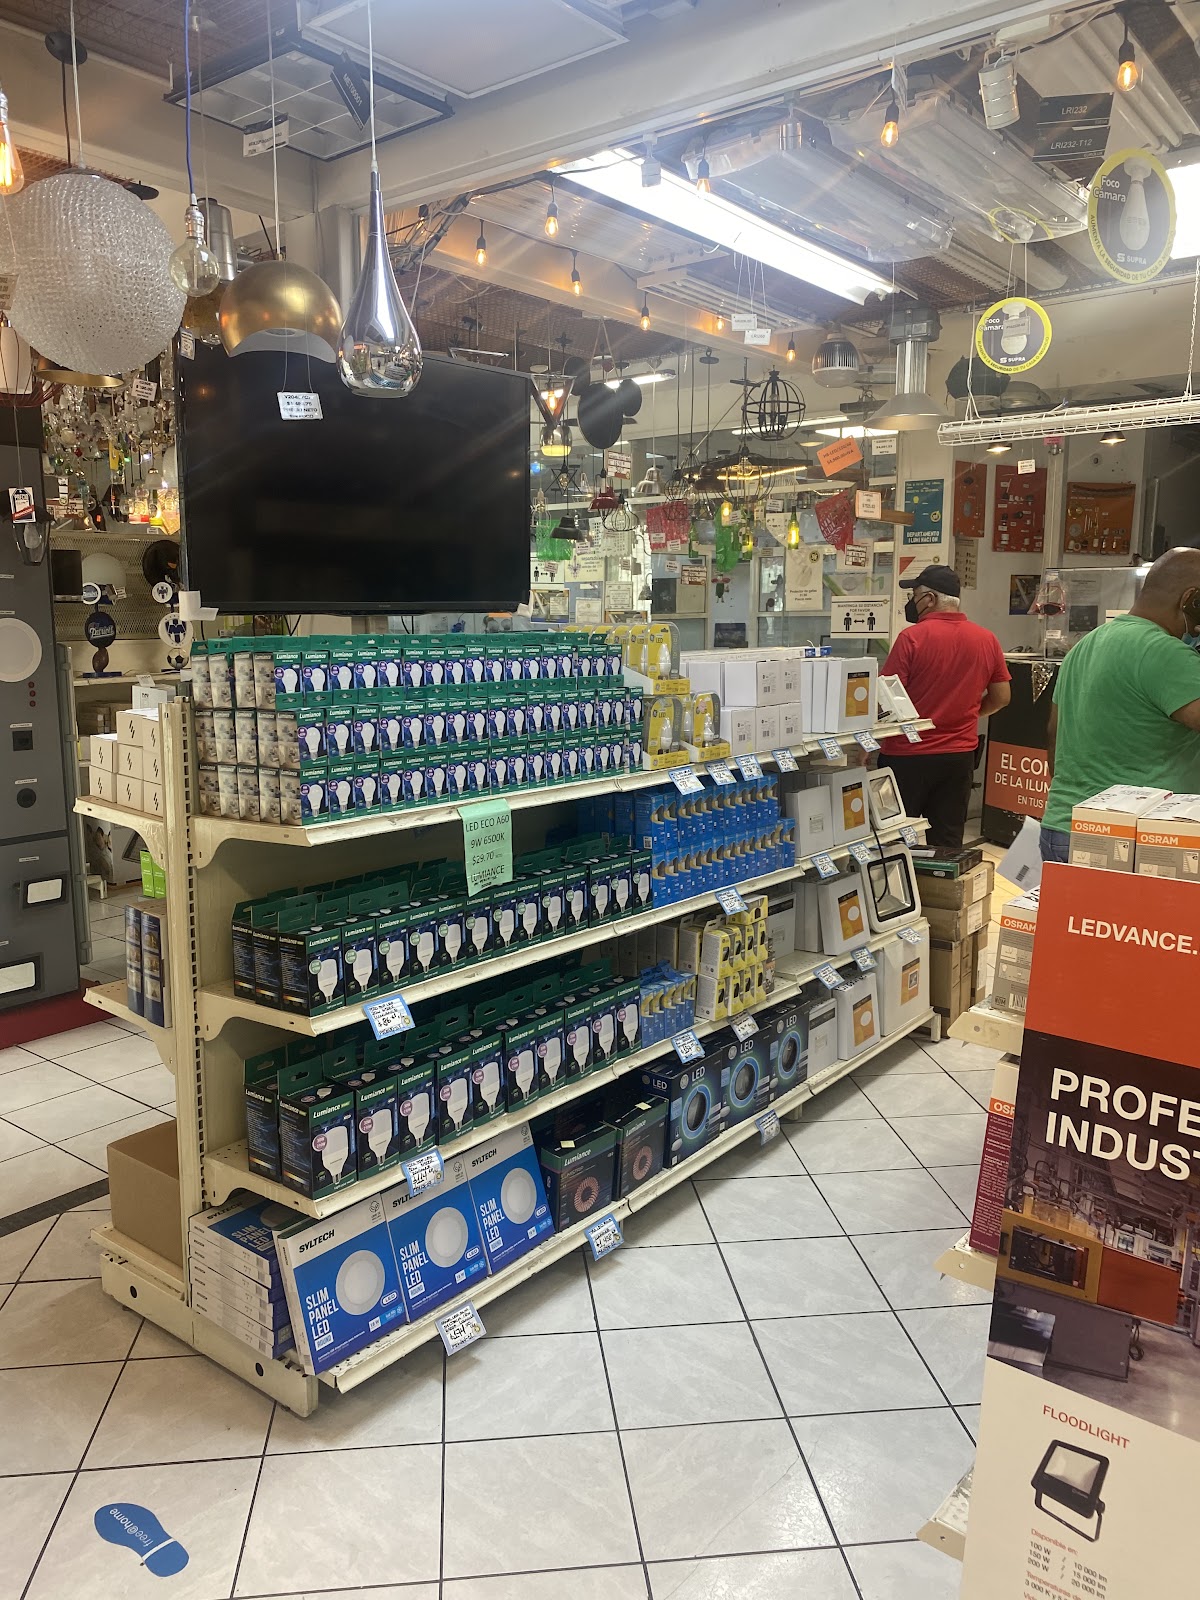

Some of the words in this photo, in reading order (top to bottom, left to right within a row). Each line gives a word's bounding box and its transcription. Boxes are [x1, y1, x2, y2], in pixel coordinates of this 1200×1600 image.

[1061, 105, 1088, 115] LRI232
[1101, 176, 1120, 188] Foco
[1093, 187, 1126, 202] Cámara
[1090, 214, 1101, 250] AUMENTA
[1104, 258, 1130, 279] SEGURIDAD
[1126, 256, 1146, 264] SUPRA
[990, 361, 1012, 371] SEGURIDAD
[1001, 752, 1016, 771] EL
[995, 772, 1008, 786] DE
[1010, 776, 1022, 789] LA
[1017, 795, 1027, 805] EN
[1029, 797, 1043, 809] TUS
[466, 822, 478, 832] LED
[481, 818, 494, 829] ECO
[497, 814, 509, 824] A60
[1075, 822, 1110, 834] OSRAM
[471, 839, 482, 848] 9W
[484, 832, 505, 844] 6500K
[1140, 834, 1178, 845] OSRAM
[472, 851, 494, 865] $29.70
[471, 865, 505, 882] LUMIANCE
[410, 912, 428, 920] Lumiance
[380, 920, 399, 928] Lumiance
[1004, 918, 1036, 931] OSRAM
[345, 928, 365, 937] Lumiance
[1068, 916, 1198, 955] LEDVANCE.
[310, 937, 331, 946] Lumiance
[786, 1014, 797, 1028] LED
[509, 1031, 528, 1043] Lumiance
[472, 1042, 493, 1055] Lumiance
[741, 1040, 754, 1054] LED
[441, 1058, 461, 1071] Lumiance
[401, 1072, 424, 1085] Lumiance
[692, 1066, 705, 1082] LED
[652, 1079, 667, 1090] LED
[246, 1089, 264, 1101] Lumiance
[361, 1087, 385, 1102] Lumiance
[280, 1101, 299, 1114] Lumiance
[313, 1104, 340, 1119] Lumiance
[626, 1120, 646, 1137] Lumiance
[471, 1149, 497, 1167] SYLTECH
[564, 1149, 591, 1167] Lumiance
[480, 1198, 497, 1216] SLIM
[483, 1209, 505, 1229] PANEL
[232, 1225, 258, 1238] SLIM
[486, 1226, 499, 1242] LED
[248, 1236, 270, 1248] LED
[299, 1229, 335, 1253] SYLTECH
[400, 1240, 420, 1260] SLIM
[403, 1252, 428, 1275] PANEL
[405, 1271, 421, 1289] LED
[306, 1286, 329, 1310] SLIM
[309, 1300, 339, 1326] PANEL
[312, 1319, 330, 1340] LED
[1043, 1404, 1130, 1449] FLOODLIGHT
[109, 1508, 154, 1547] free@home
[1031, 1528, 1066, 1550] Disponible
[1030, 1541, 1042, 1551] 100
[1044, 1547, 1051, 1555] W
[1074, 1562, 1082, 1570] 10
[1084, 1566, 1097, 1578] 000
[1098, 1574, 1107, 1582] lm
[1028, 1557, 1040, 1568] 200
[1041, 1564, 1049, 1572] W
[1072, 1579, 1080, 1587] 20
[1082, 1583, 1095, 1594] 000
[1029, 1550, 1041, 1560] 150
[1043, 1555, 1050, 1563] W
[1073, 1570, 1081, 1578] 15
[1082, 1574, 1096, 1586] 000
[1097, 1582, 1106, 1591] lm
[1026, 1570, 1070, 1597] Temperaturas
[1031, 1582, 1044, 1593] 000
